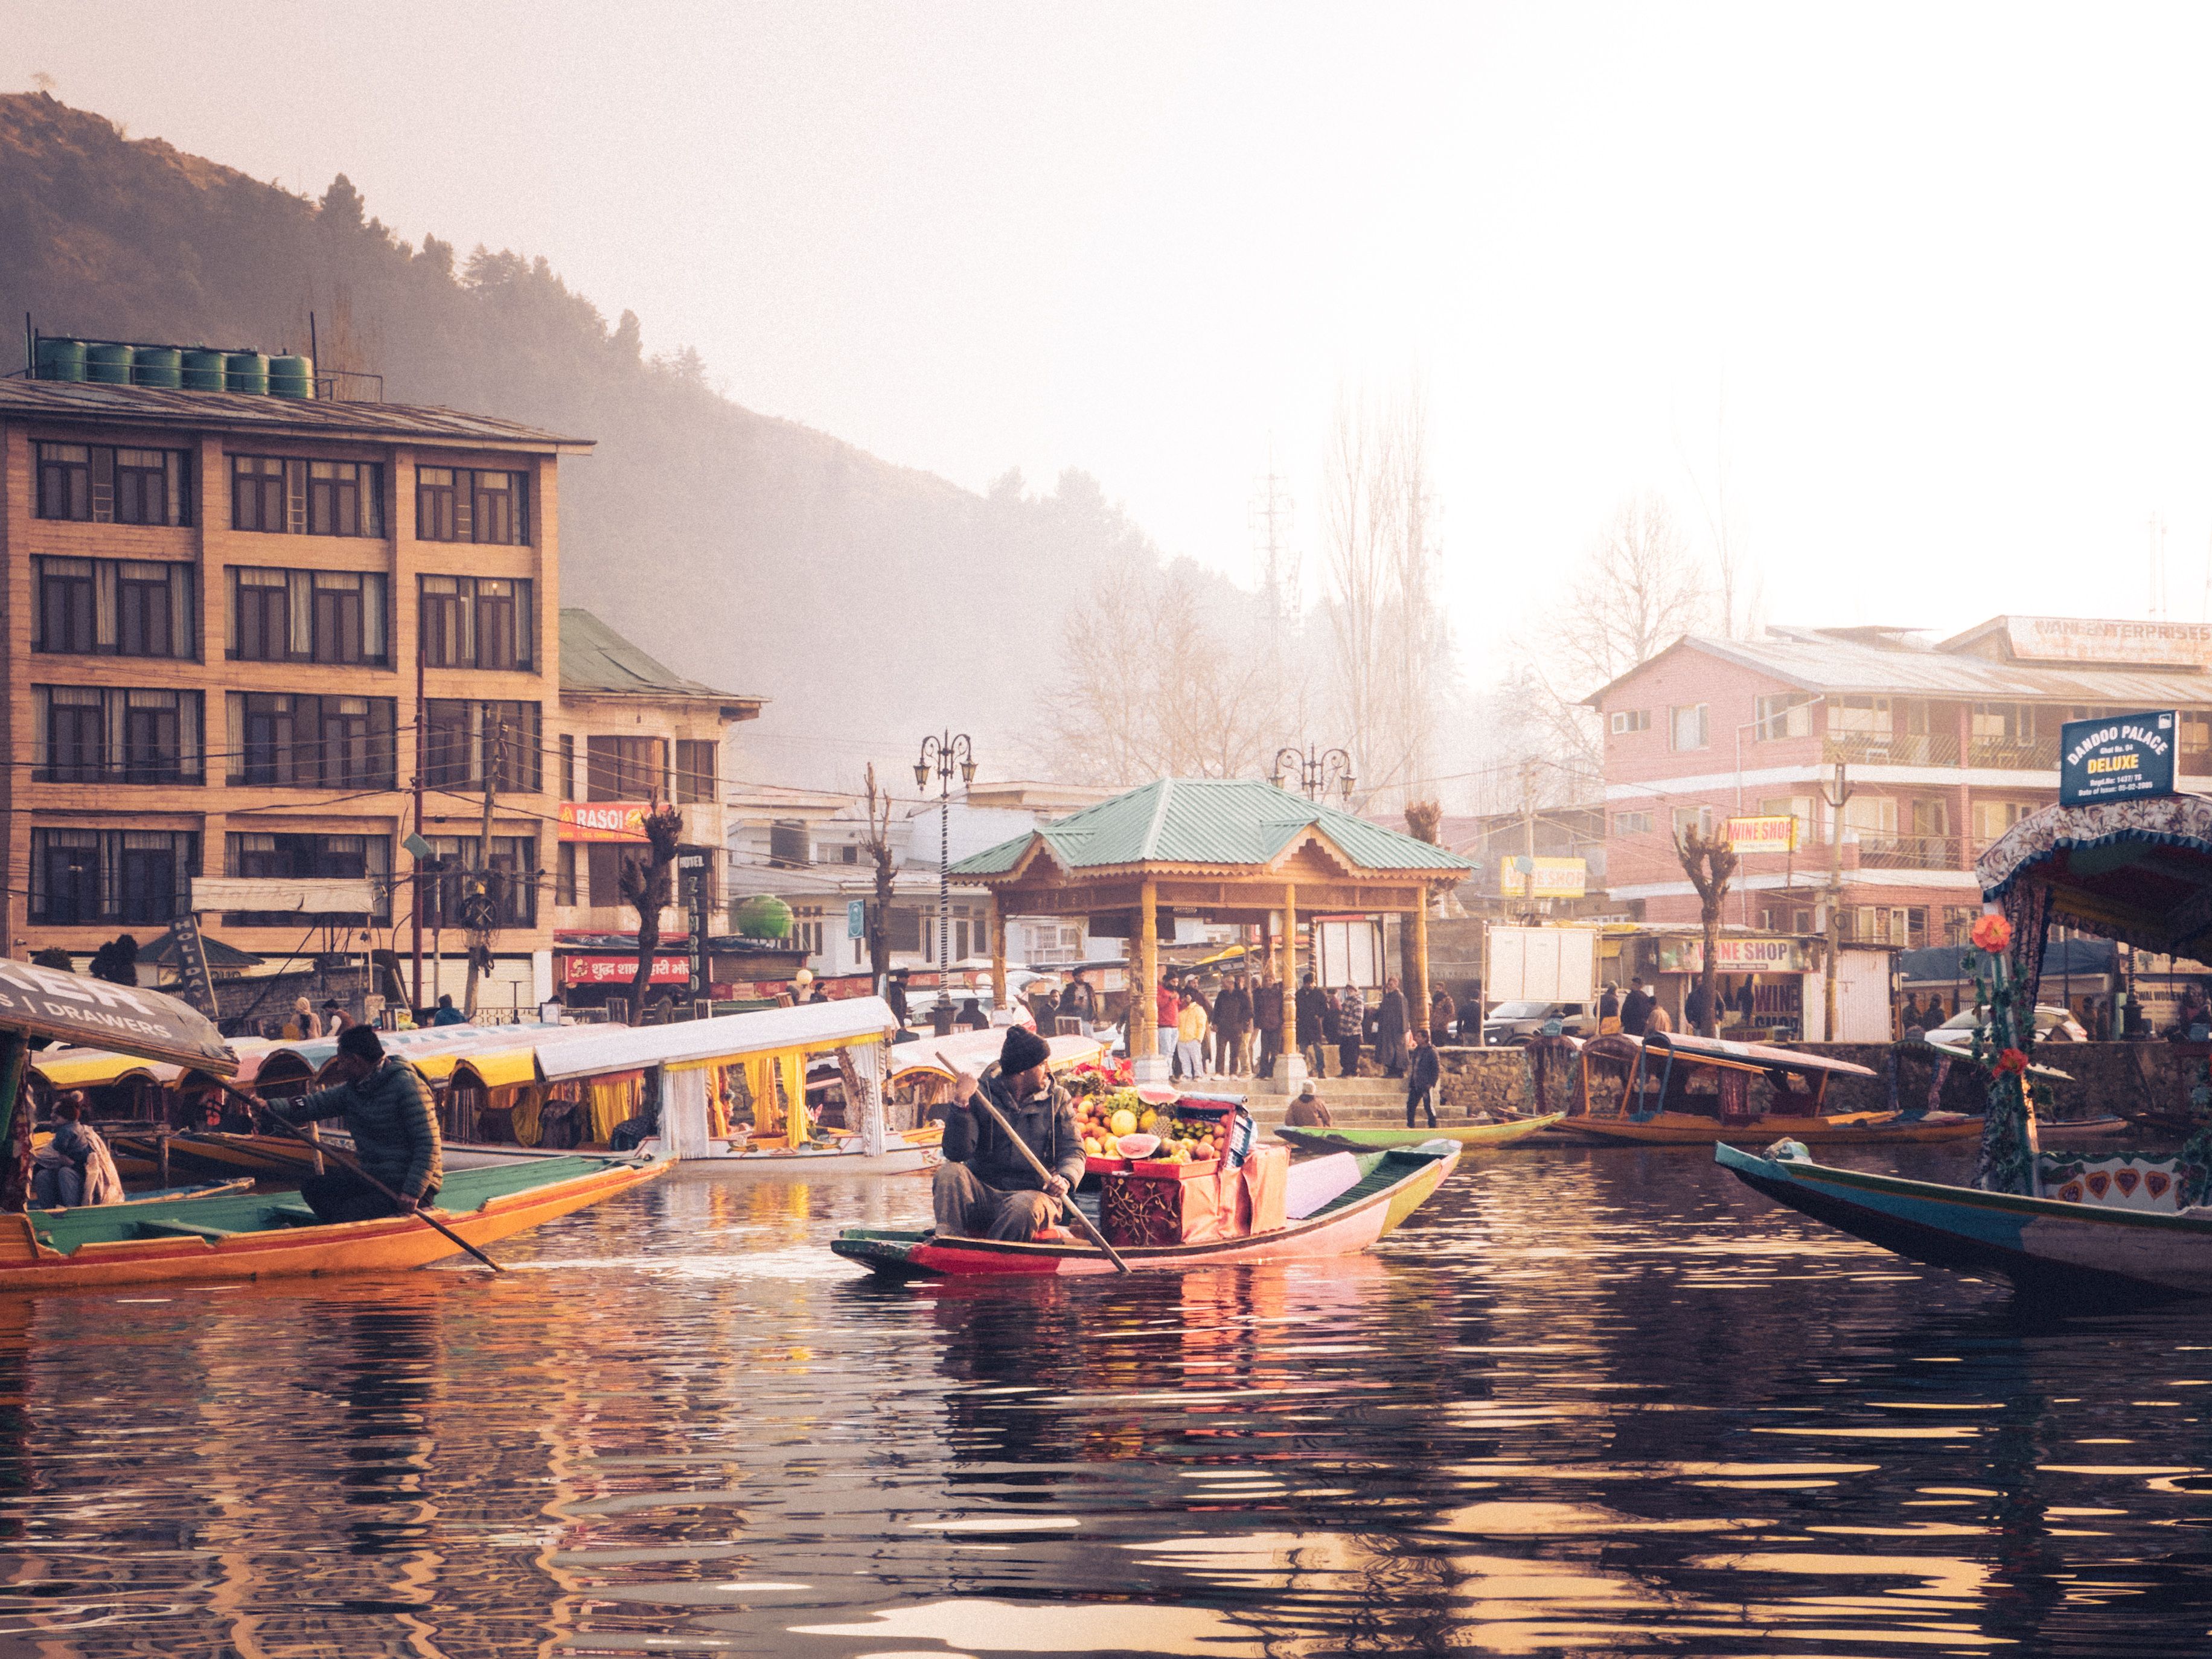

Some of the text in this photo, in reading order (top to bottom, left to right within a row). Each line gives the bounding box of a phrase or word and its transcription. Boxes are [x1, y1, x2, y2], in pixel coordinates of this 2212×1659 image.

[2067, 726, 2169, 766] DANDOO PALACE
[2087, 753, 2140, 775] DELUXE
[576, 808, 624, 830] RASOI
[1729, 821, 1791, 840] WINE SHOP
[679, 855, 705, 868] HOTEL
[174, 920, 207, 999] HOLIDAY
[1744, 942, 1787, 961] SHOP
[592, 963, 615, 980] शुद्ध
[1754, 985, 1799, 1012] WINE
[43, 1001, 173, 1039] DRAWERS
